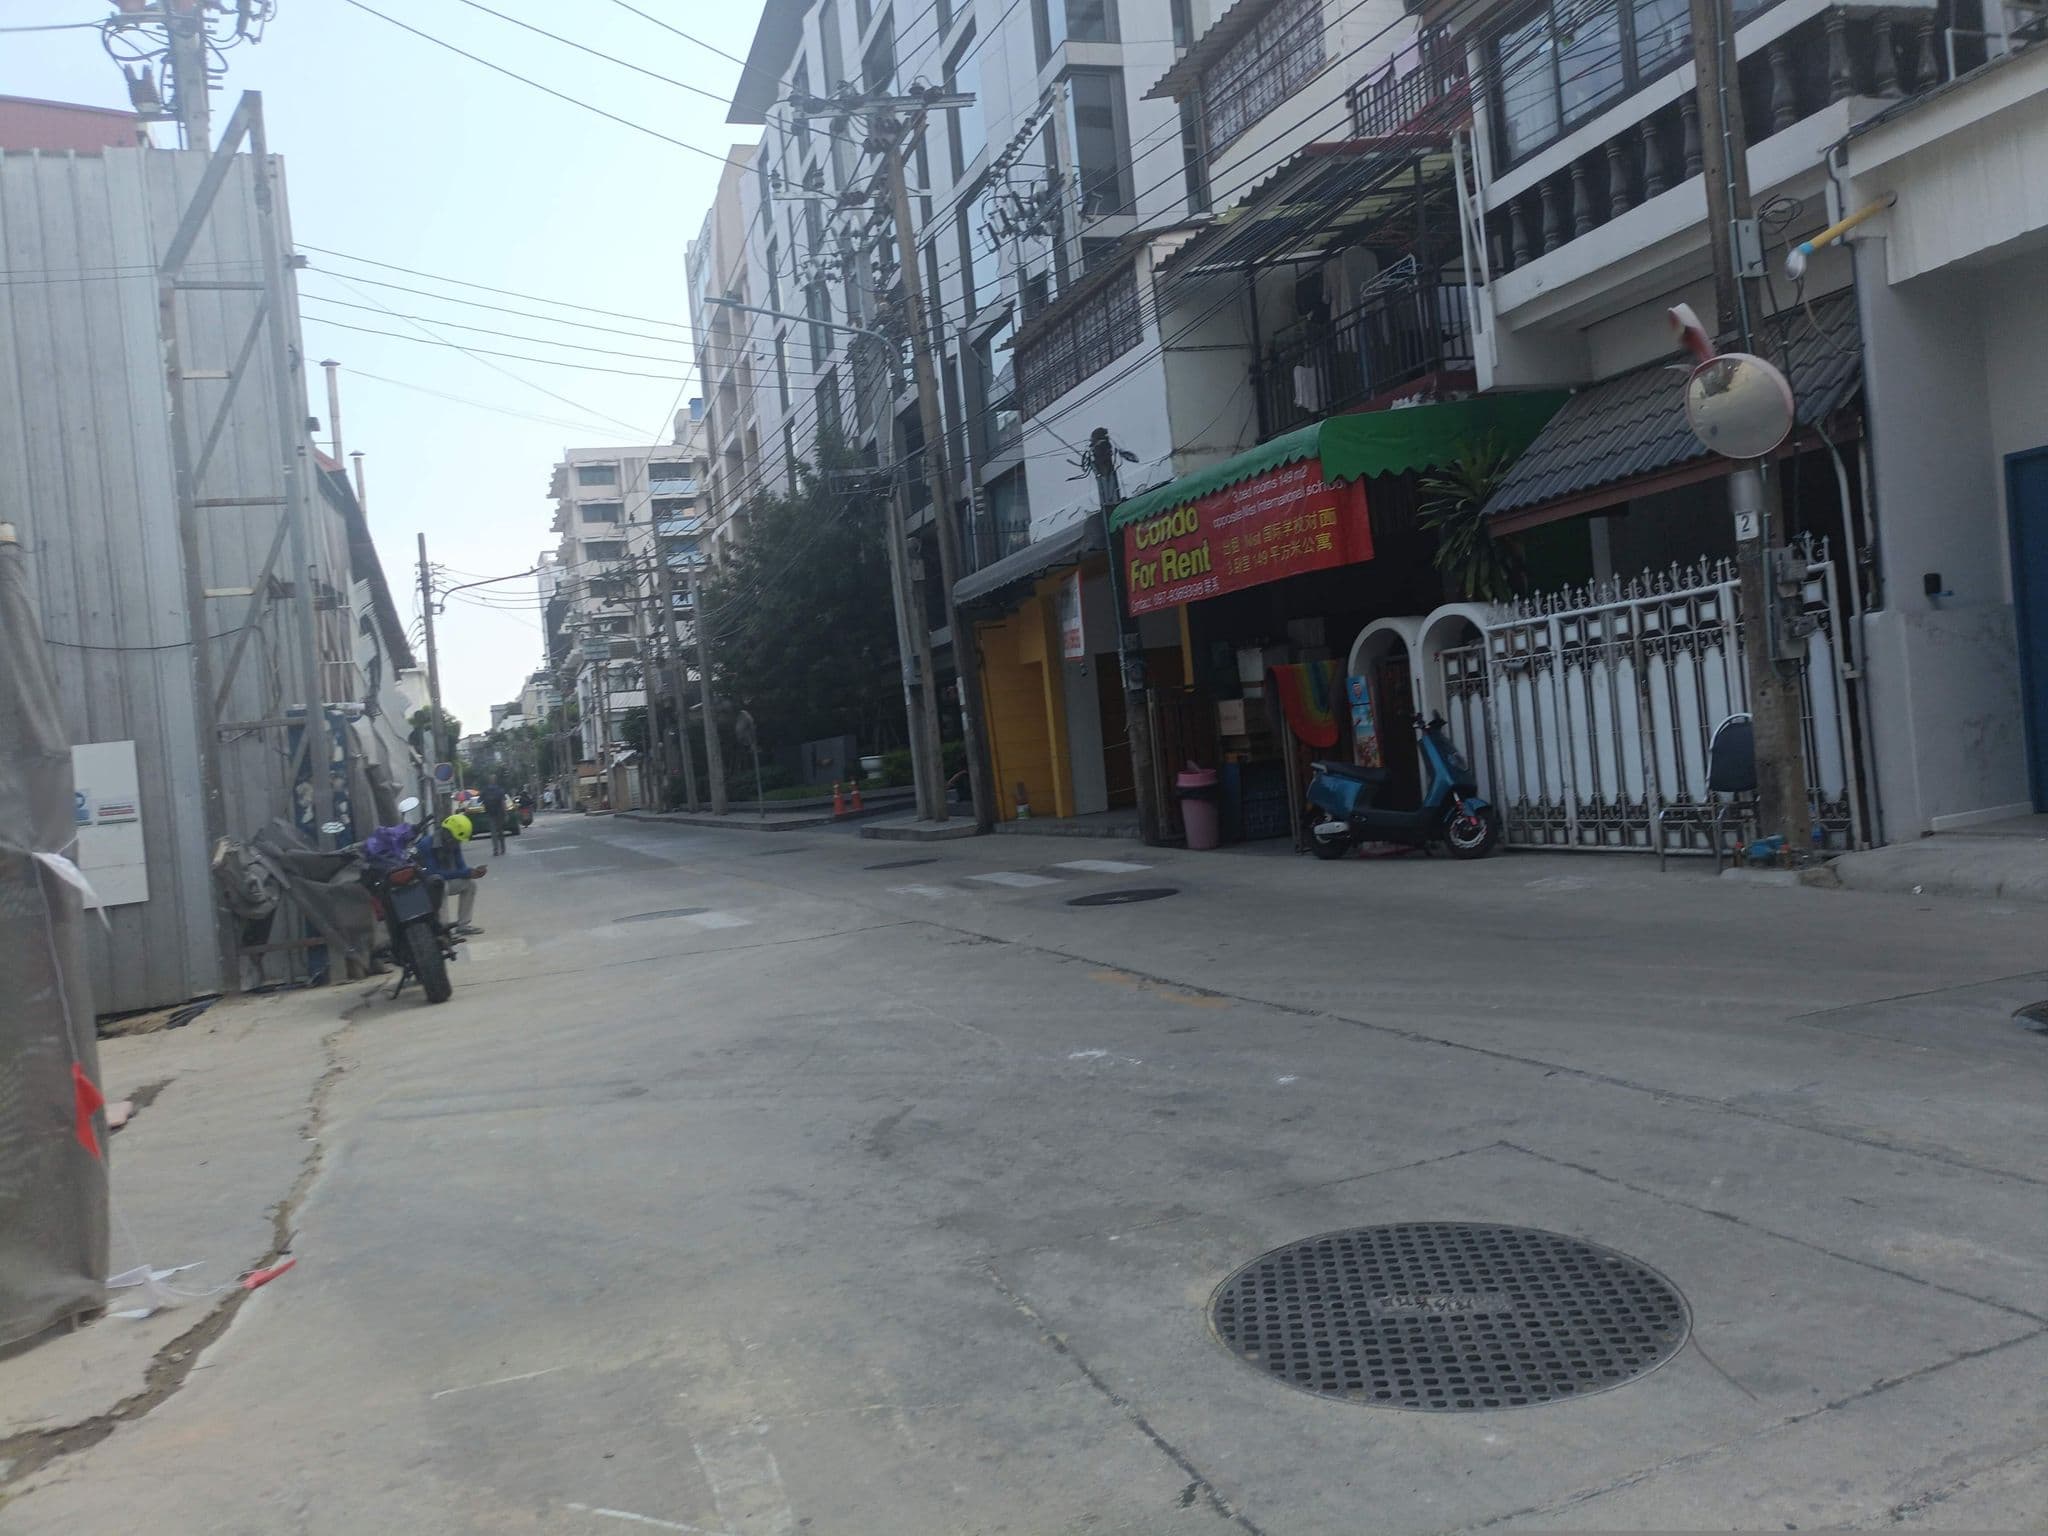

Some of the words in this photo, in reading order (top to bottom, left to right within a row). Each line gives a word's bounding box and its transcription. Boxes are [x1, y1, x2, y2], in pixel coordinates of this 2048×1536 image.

[1135, 506, 1198, 550] Condo
[1740, 514, 1750, 532] 2
[1130, 558, 1157, 592] For
[1161, 538, 1211, 583] Rent
